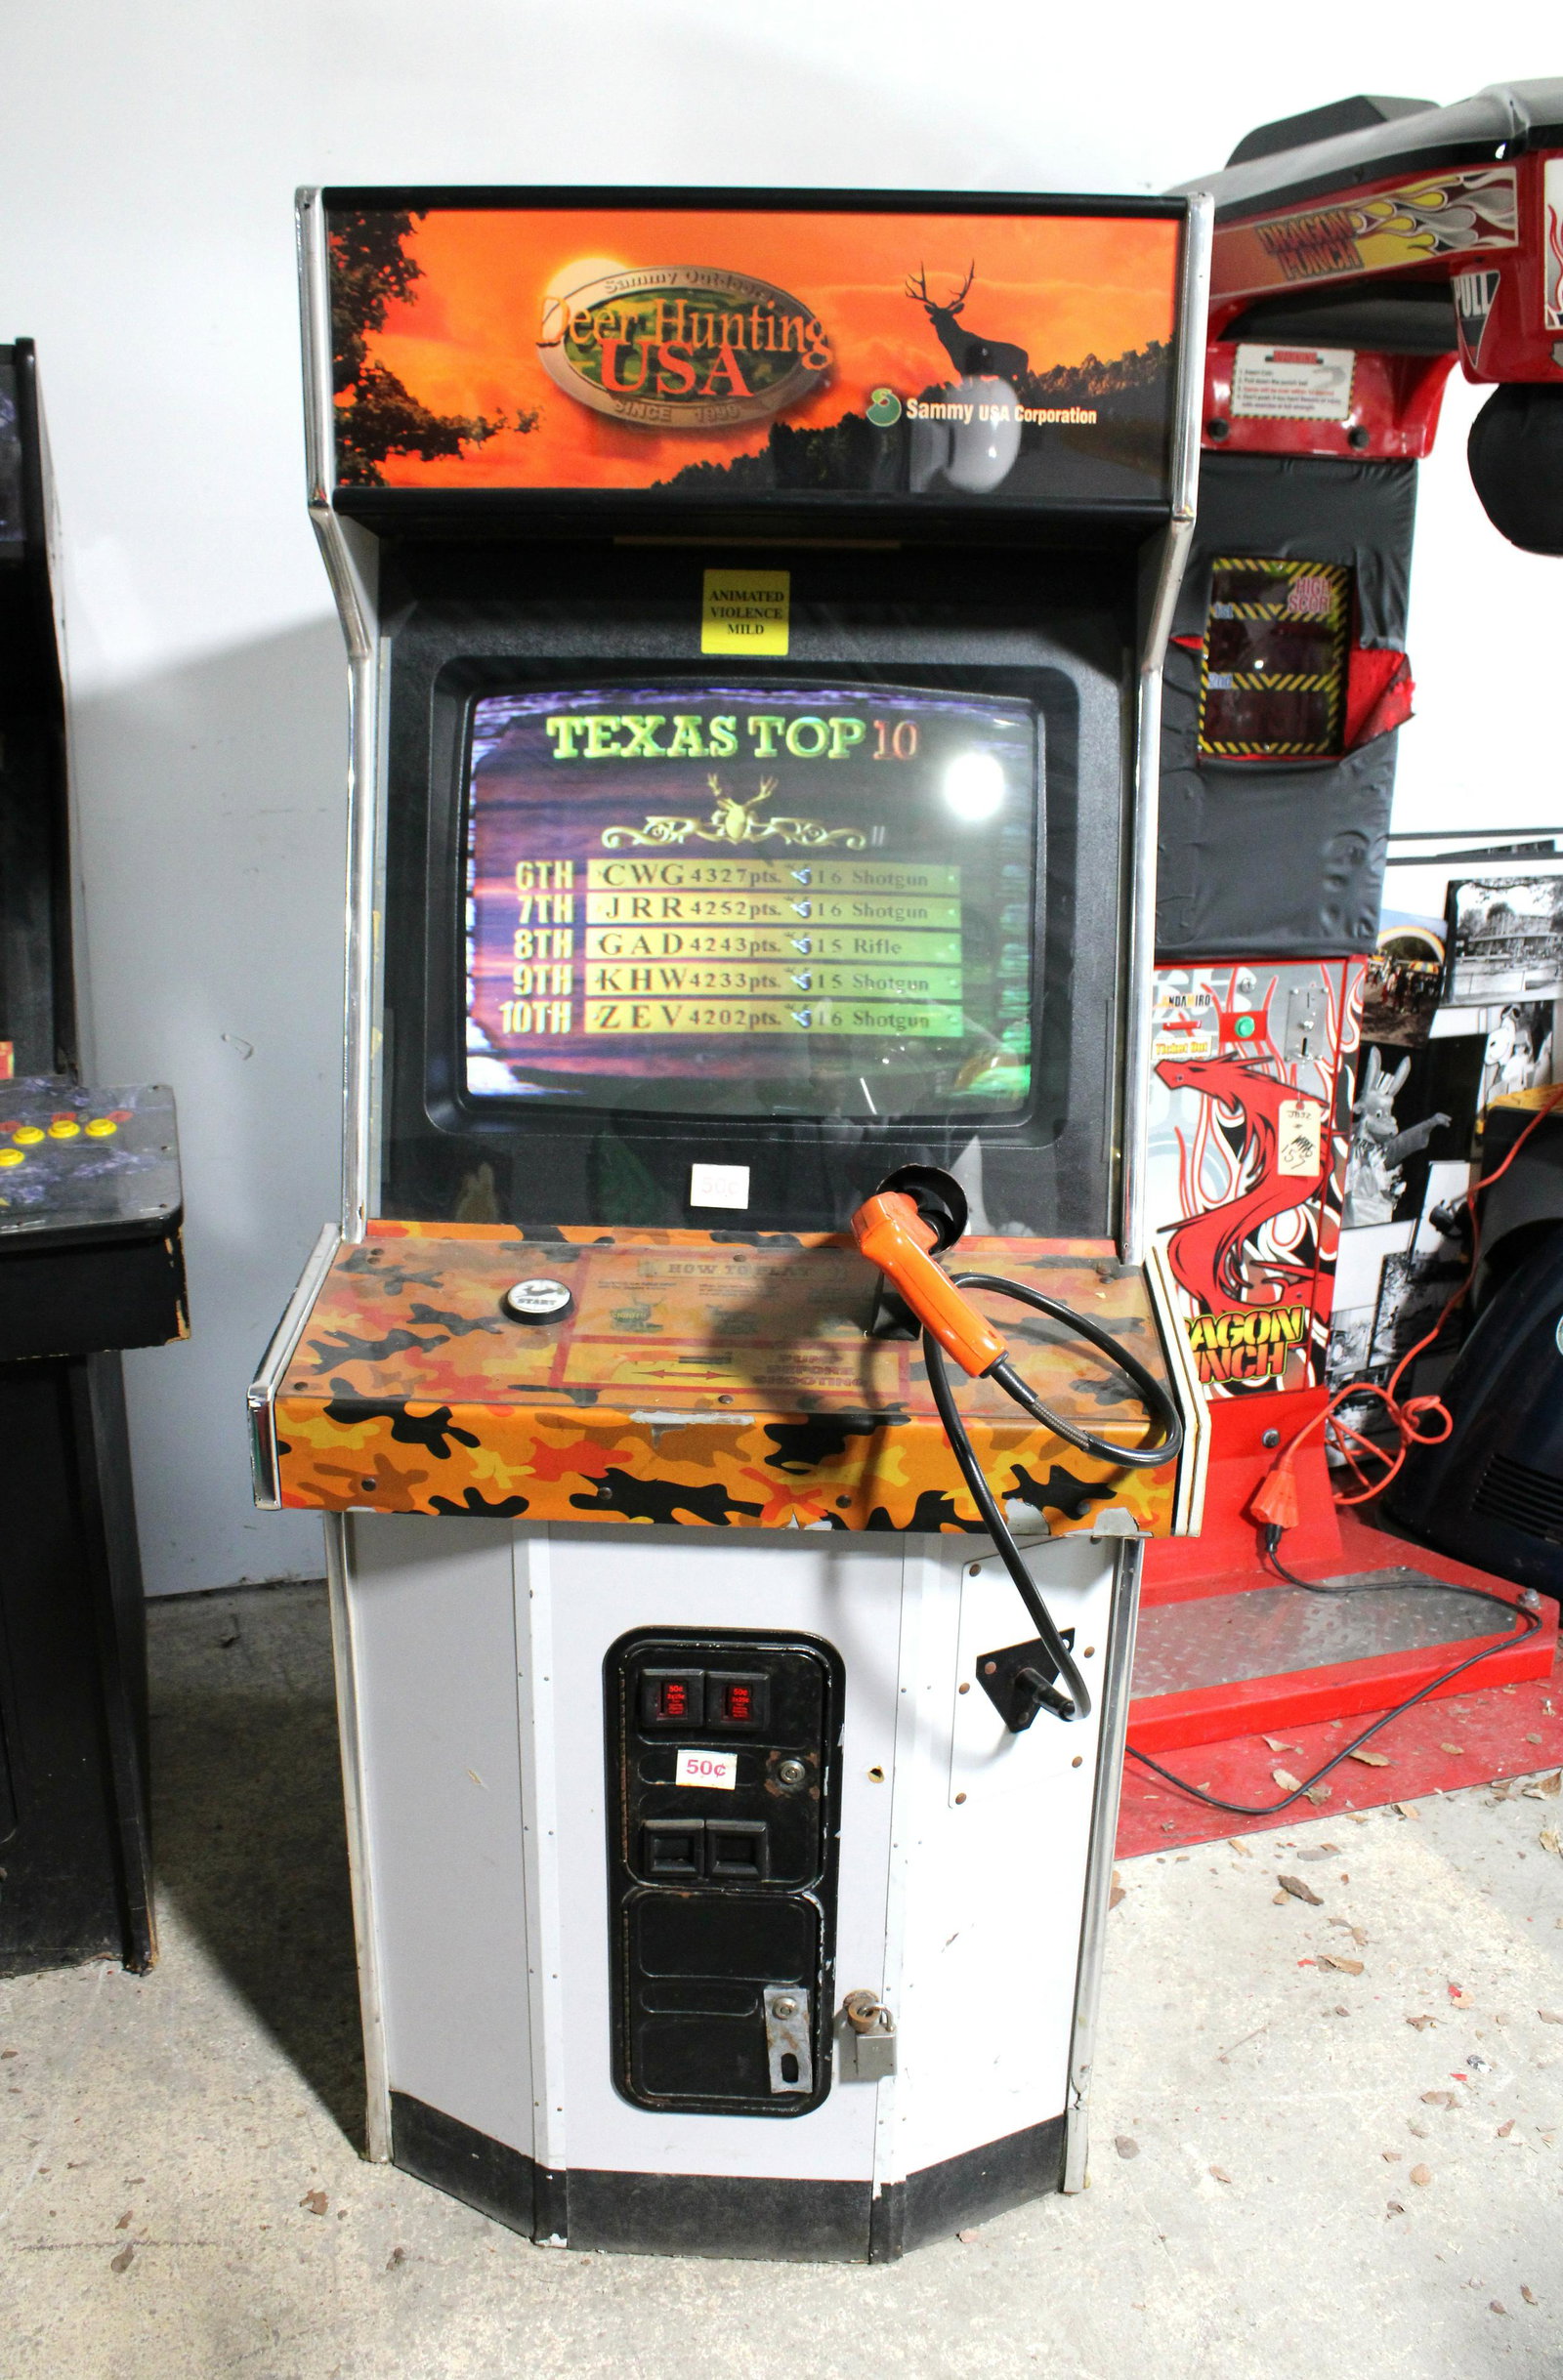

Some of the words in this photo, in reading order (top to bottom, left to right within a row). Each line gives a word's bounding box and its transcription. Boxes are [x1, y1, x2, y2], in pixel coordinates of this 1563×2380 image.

[604, 271, 678, 295] Sammy
[536, 296, 638, 349] Deer
[653, 298, 831, 371] Hunting
[598, 339, 754, 397] USA
[613, 398, 672, 422] SINCE
[907, 398, 973, 425] Sammy
[979, 405, 1010, 422] USA
[1014, 405, 1097, 426] Corporation
[709, 590, 784, 603] ANIMATED
[1296, 577, 1331, 595] HIGH
[710, 606, 783, 619] VIOLENCE
[728, 624, 765, 635] MILD
[546, 715, 739, 760] TEXAS
[747, 716, 866, 760] TOP
[872, 719, 919, 761] 10
[516, 859, 573, 891] 6TH
[603, 863, 684, 886] CWG
[818, 870, 842, 885] 16
[852, 871, 929, 889] Shotgun
[517, 893, 573, 924] 7TH
[606, 897, 684, 919] JRR
[818, 903, 842, 918] 16
[852, 902, 928, 922] Shotgun
[514, 928, 573, 961] 8TH
[599, 933, 684, 955] GAD
[818, 939, 842, 953] 15
[854, 937, 903, 955] Rifle
[513, 964, 573, 996] 9TH
[599, 968, 687, 992] KHW
[818, 975, 843, 989] 15
[852, 974, 929, 993] Shotgun
[499, 1000, 572, 1034] 10TH
[599, 1005, 683, 1029] ZEV
[818, 1010, 843, 1025] 16
[852, 1010, 930, 1031] Shotgun
[1156, 1042, 1189, 1056] Ticket
[1190, 1041, 1208, 1054] Out
[668, 1264, 718, 1274] HOW
[725, 1265, 749, 1274] TO
[1184, 1307, 1302, 1350] AGON
[1193, 1341, 1285, 1384] NCH
[686, 1759, 727, 1777] 50¢
